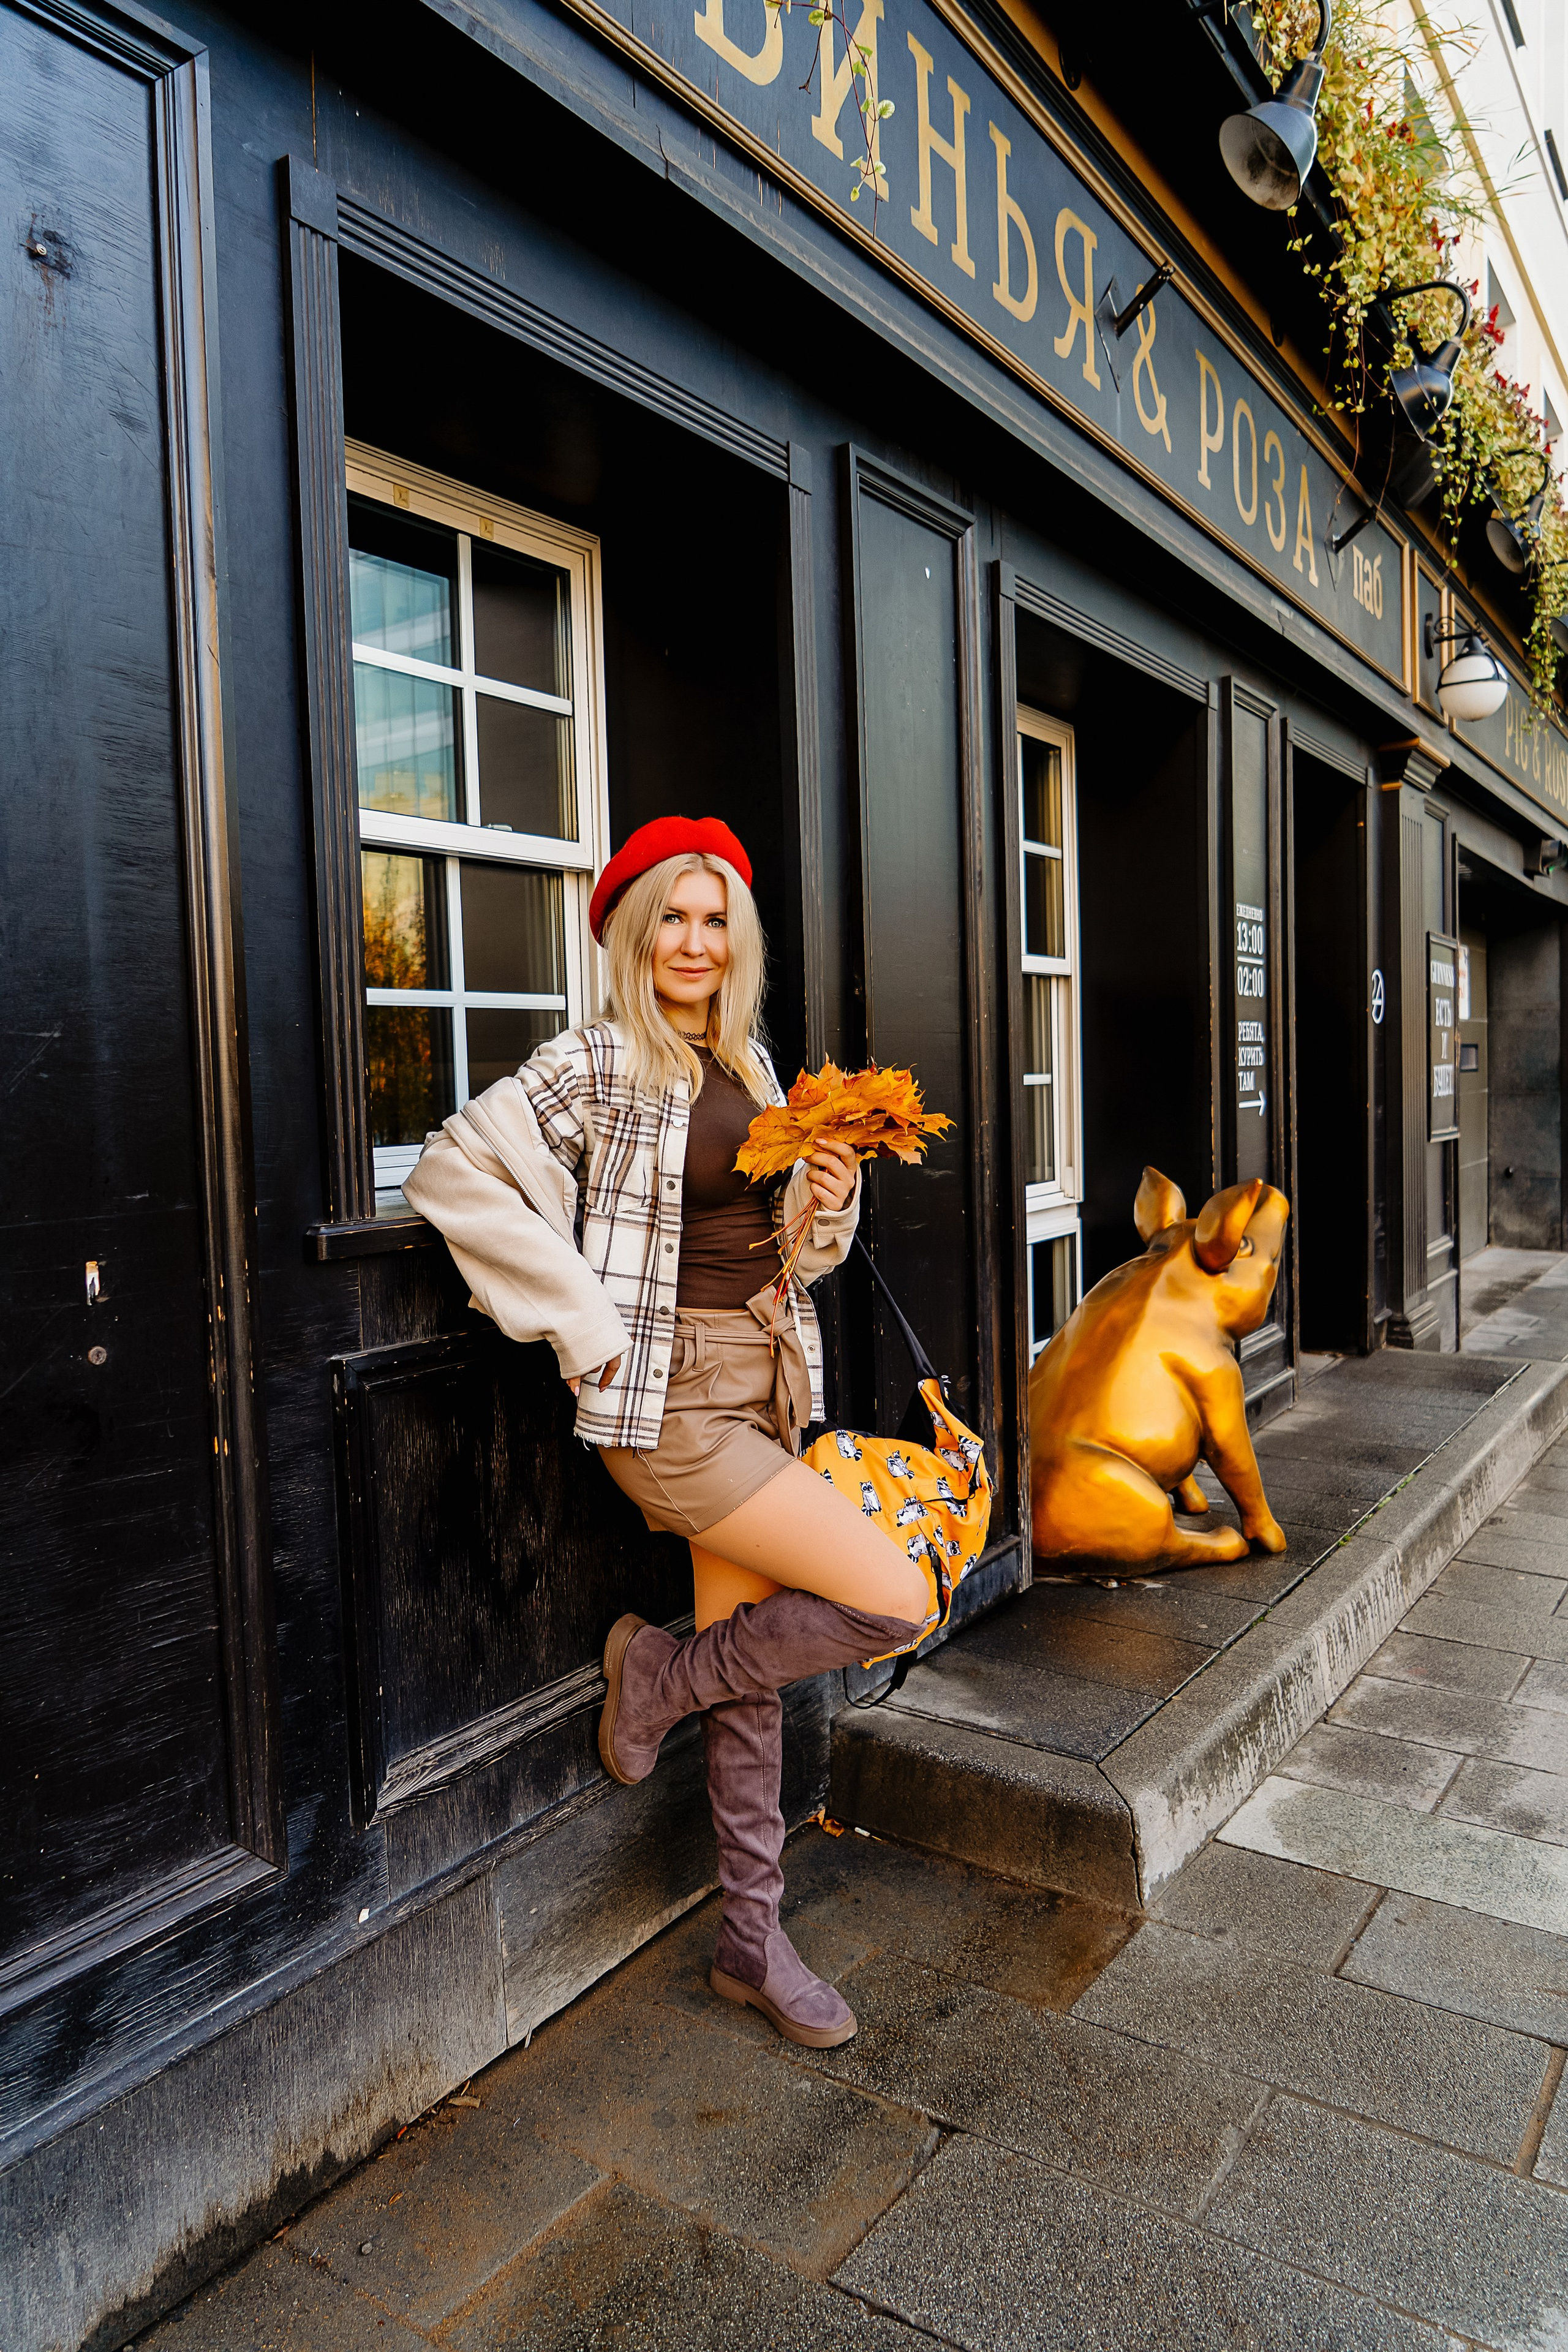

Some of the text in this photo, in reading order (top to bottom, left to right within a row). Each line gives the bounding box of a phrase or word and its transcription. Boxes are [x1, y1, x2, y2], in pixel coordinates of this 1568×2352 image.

[1133, 284, 1171, 453] &
[1196, 348, 1318, 588] РОЗА
[1352, 544, 1382, 620] паб
[1505, 690, 1568, 812] PIG & ROS
[1237, 921, 1264, 955] 13:00
[1237, 965, 1264, 997] 02:00
[1435, 997, 1452, 1027] ЕСТЬ
[1238, 1021, 1265, 1044] РЕБЯТА,
[1441, 1031, 1448, 1059] И
[1238, 1046, 1265, 1066] КУРИТЬ
[1238, 1070, 1256, 1091] ТАМ
[1433, 1063, 1453, 1097] БУДЕТ
